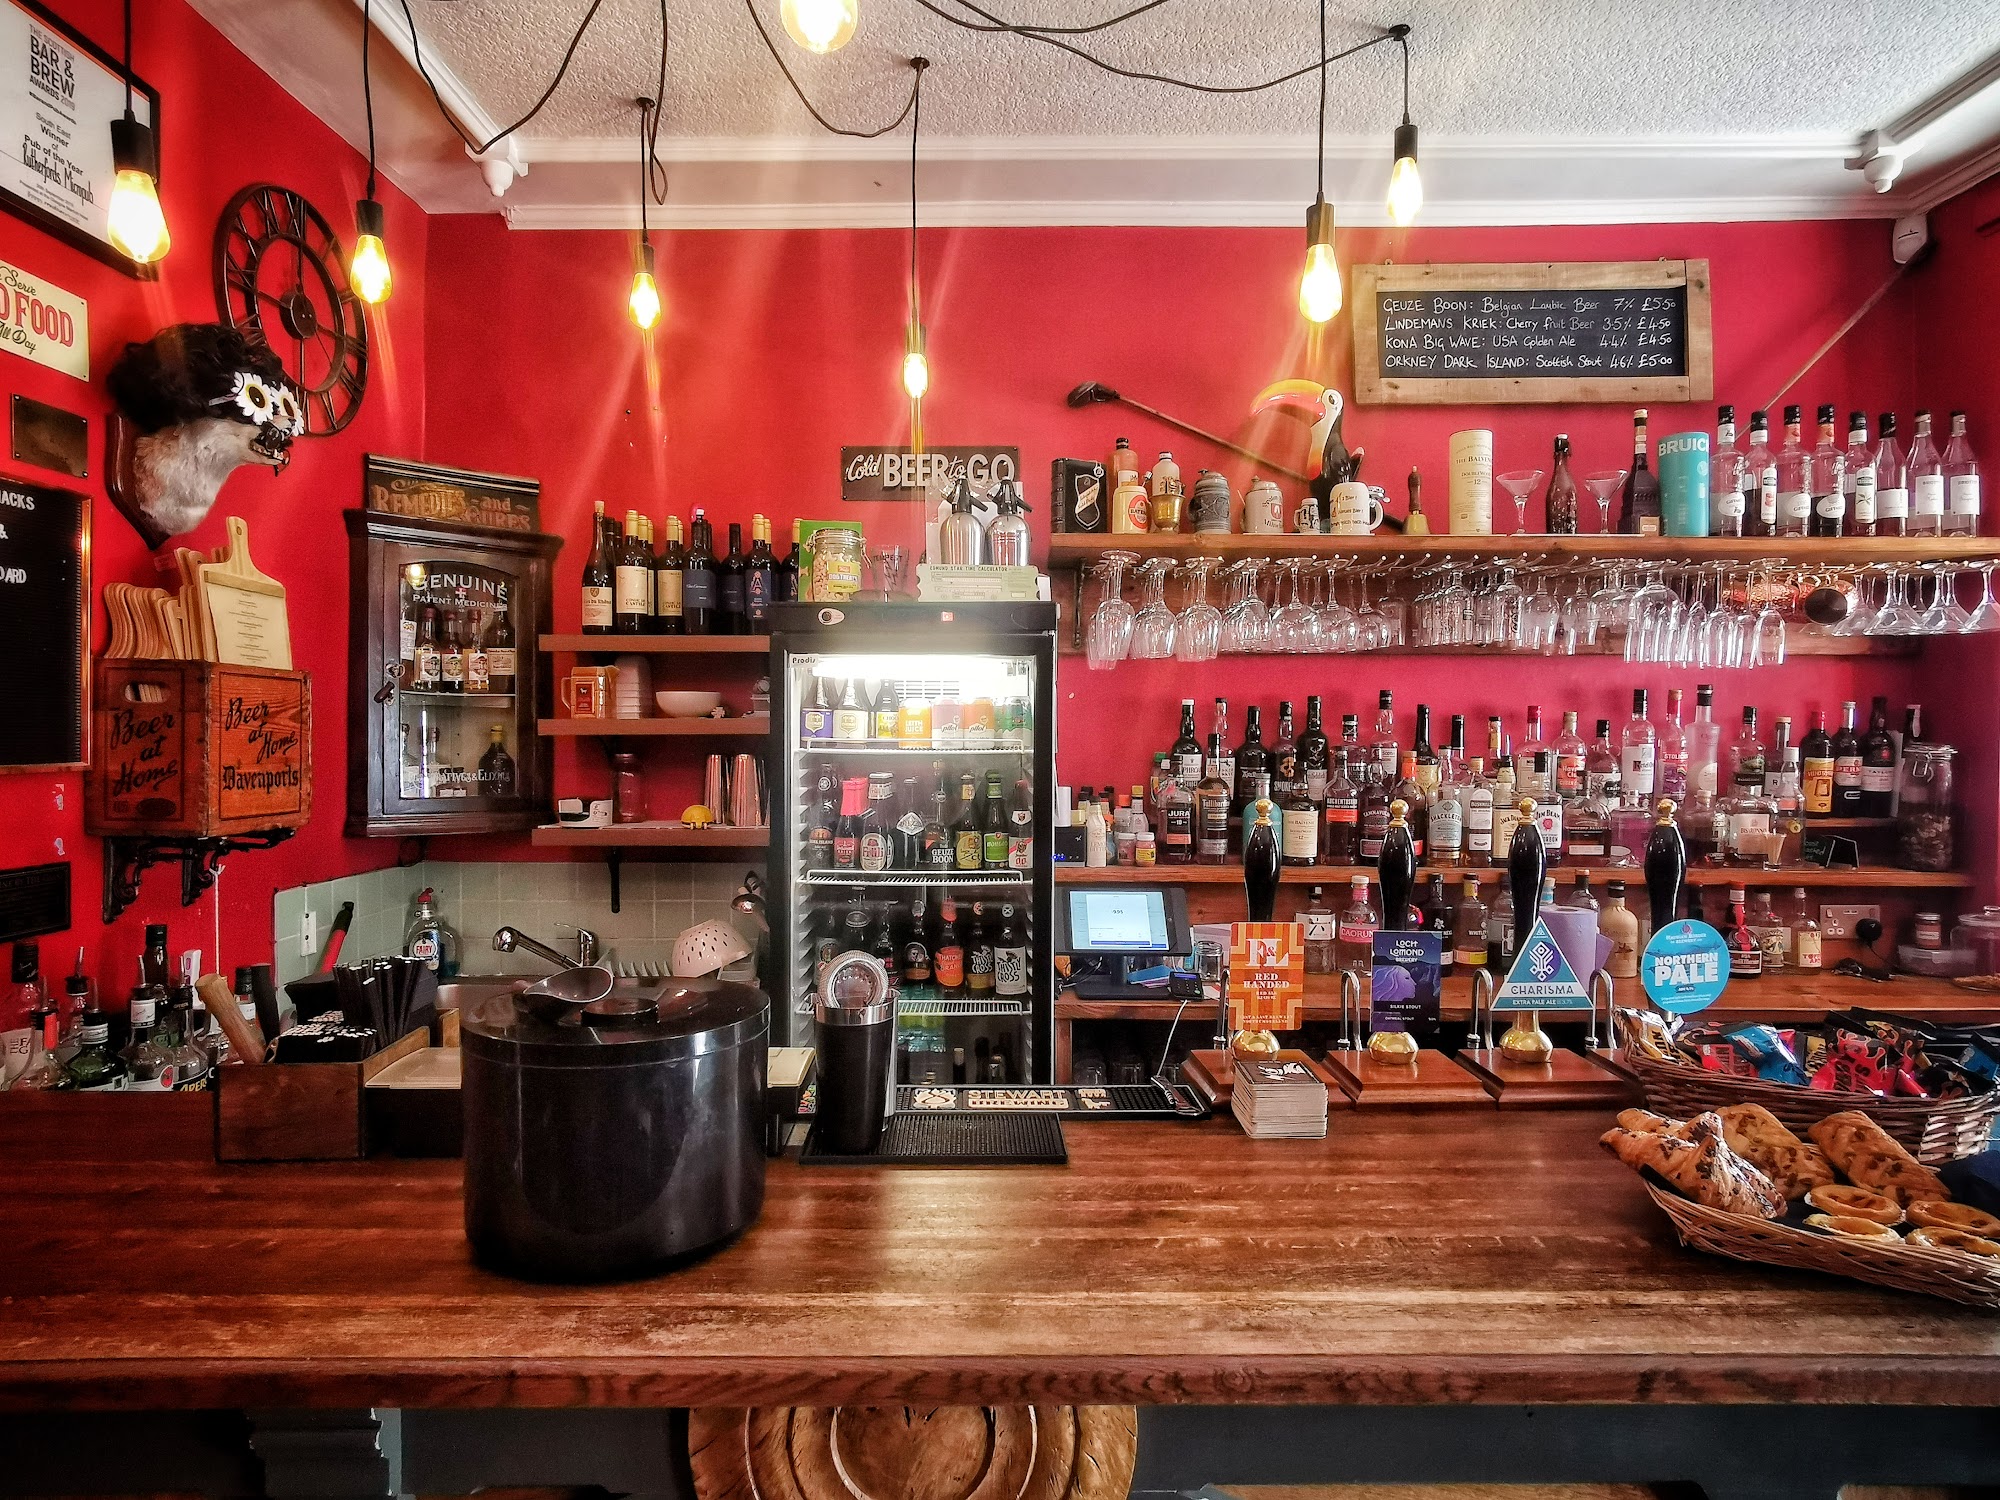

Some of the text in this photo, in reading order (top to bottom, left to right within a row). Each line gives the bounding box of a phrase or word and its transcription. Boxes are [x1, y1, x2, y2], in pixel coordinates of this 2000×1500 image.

[31, 34, 74, 81] BAR &
[31, 54, 74, 98] BREW
[30, 75, 60, 101] AWARDS
[35, 112, 71, 140] South East
[40, 124, 69, 148] Winner
[25, 134, 83, 176] Pub of the Year
[52, 143, 58, 151] of
[5, 269, 37, 296] Serve
[1383, 298, 1425, 314] GEUZE
[1433, 297, 1474, 314] BOON:
[1481, 296, 1523, 318] Belgian
[1573, 297, 1600, 313] Beer
[1613, 297, 1636, 311] 7%
[14, 289, 74, 348] FOOD
[1385, 317, 1453, 331] LINDEMANS
[1463, 315, 1502, 331] KRIEK:
[1506, 317, 1539, 332] Cherry
[1543, 316, 1566, 331] fruit
[1570, 316, 1596, 331] Beer
[12, 329, 37, 356] Day
[1385, 335, 1418, 349] KONA
[1423, 334, 1446, 351] BIG
[1449, 335, 1486, 349] WAVE:
[1492, 335, 1519, 348] USA
[1523, 335, 1555, 350] Golden
[1558, 335, 1576, 347] Ale
[1385, 354, 1438, 370] ORKNEY
[1444, 354, 1479, 369] DARK
[1486, 354, 1530, 369] ISLAND:
[1535, 354, 1574, 368] Scottish
[1577, 354, 1603, 368] Stout
[847, 453, 1015, 487] Cold BEER to GO
[371, 484, 466, 518] REMEDIES
[480, 496, 511, 512] and
[461, 506, 531, 532] CURES
[412, 573, 508, 600] GENUINE
[412, 594, 452, 606] PATENT
[792, 656, 816, 664] Prodis
[225, 697, 270, 731] Beer
[110, 707, 174, 749] Beer
[248, 719, 267, 745] at
[941, 724, 959, 733] pilot
[970, 724, 985, 733] pilot
[140, 735, 166, 762] at
[256, 730, 299, 765] Home
[112, 758, 178, 798] Home
[222, 764, 299, 794] Davenports
[1500, 815, 1510, 825] JACK
[1536, 810, 1561, 820] JIM BEAM
[932, 855, 954, 863] BOON
[416, 945, 432, 954] FAIRY
[1390, 948, 1424, 957] LOMOND
[1396, 940, 1418, 949] LOCH
[997, 957, 1022, 972] THISTLY
[1655, 953, 1718, 966] NORTHERN
[972, 963, 993, 974] CROSS
[997, 971, 1020, 983] CROSS
[1255, 973, 1279, 981] RED
[1655, 962, 1719, 987] PALE
[1243, 980, 1290, 989] HANDED
[1511, 985, 1574, 995] CHARISMA
[968, 1089, 1066, 1099] STEWART
